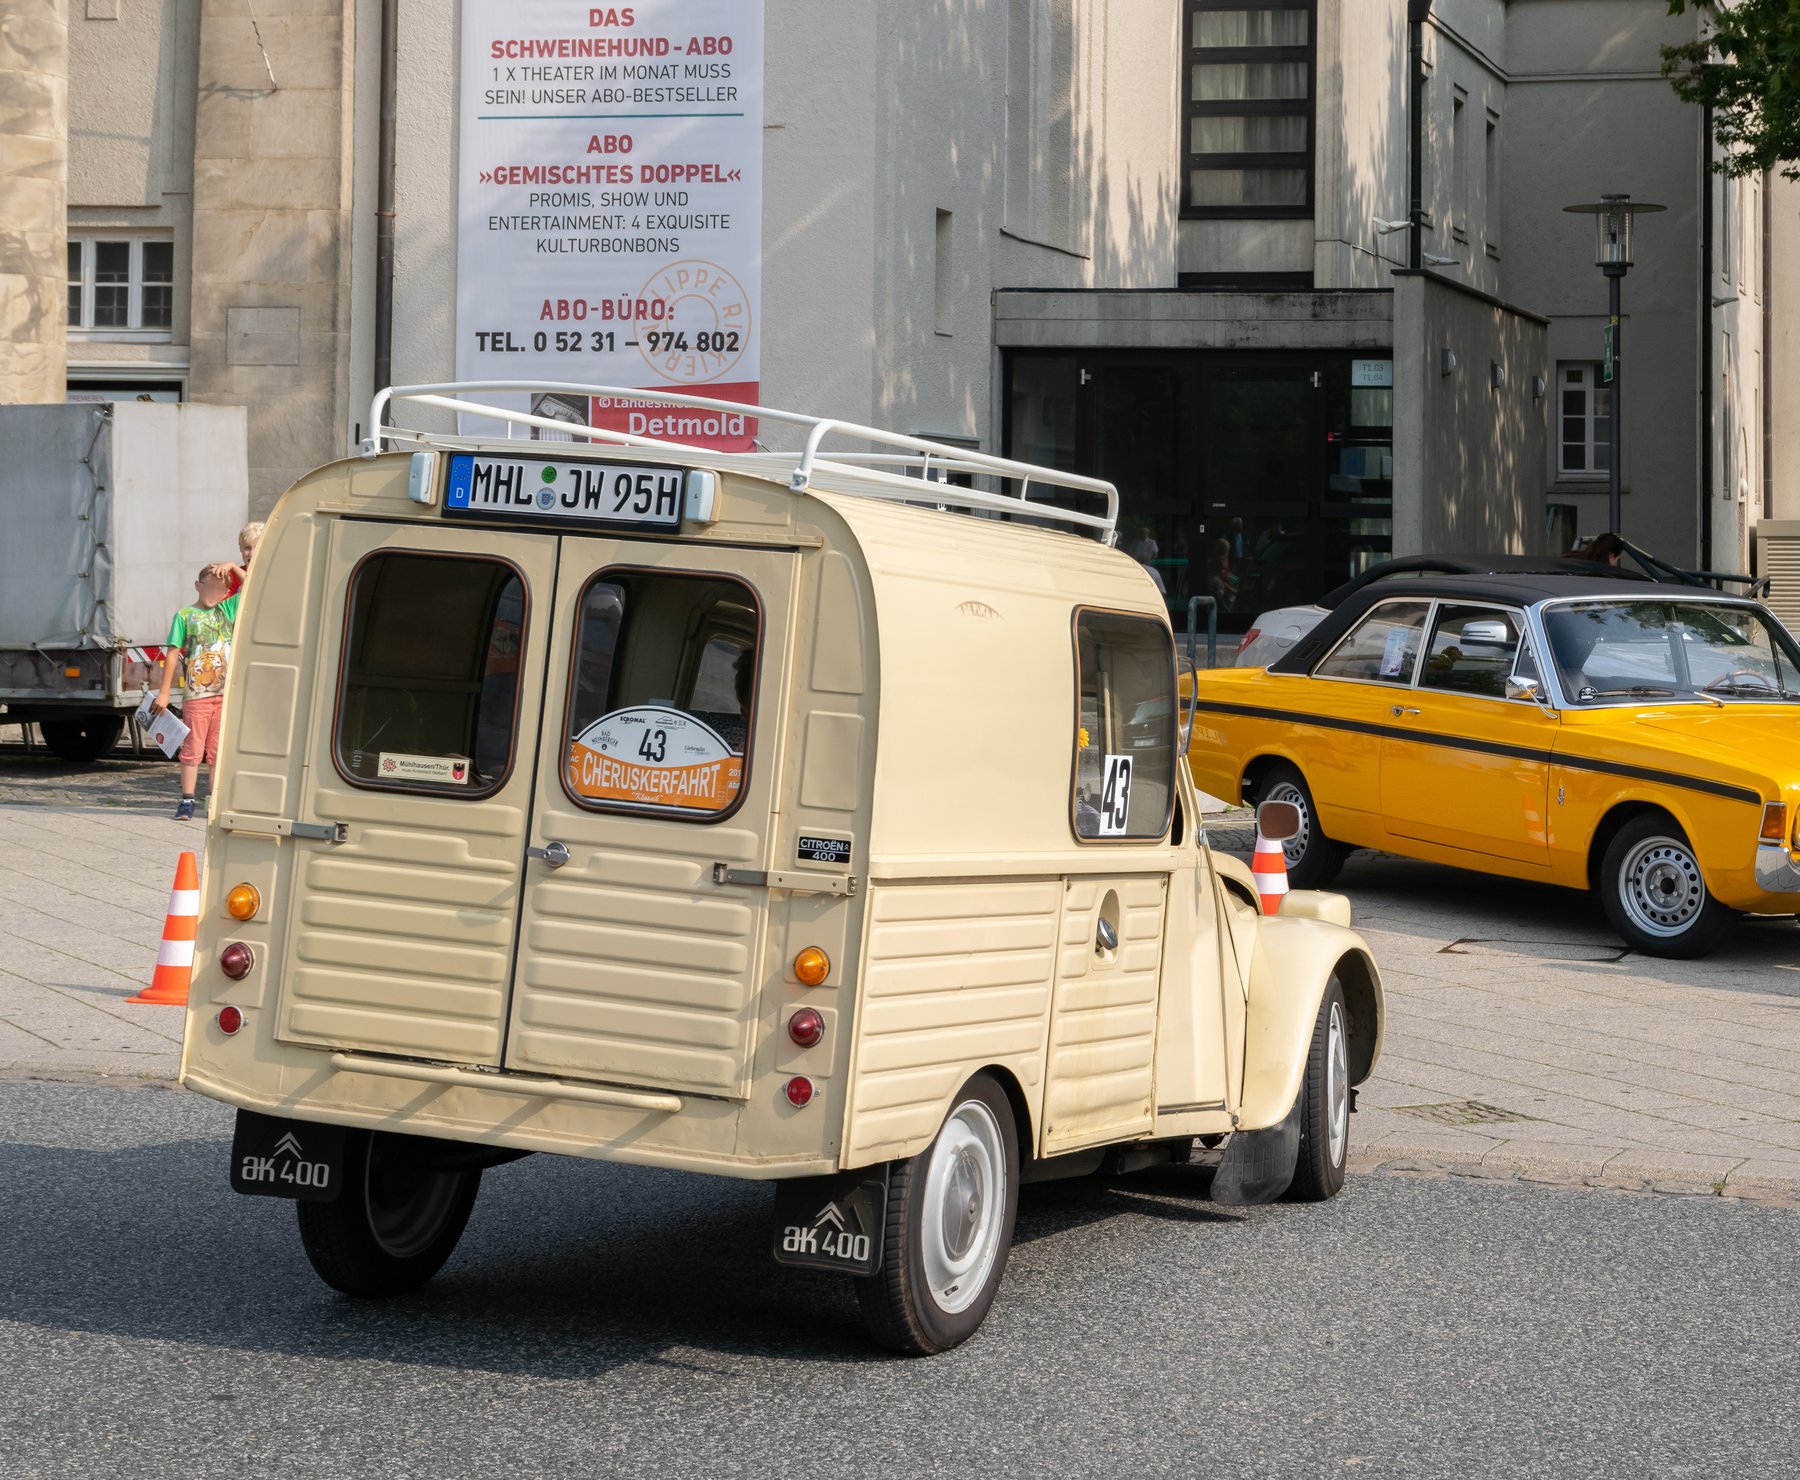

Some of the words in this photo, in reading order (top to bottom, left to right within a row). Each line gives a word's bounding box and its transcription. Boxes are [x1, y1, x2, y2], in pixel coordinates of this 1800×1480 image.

[589, 8, 635, 27] DAS
[490, 37, 669, 59] SCHWEINEHUND
[493, 67, 498, 82] 1
[505, 66, 516, 81] X
[521, 65, 594, 81] THEATER
[600, 65, 617, 80] IM
[623, 64, 679, 80] MONAT
[684, 63, 732, 79] MUSS
[484, 89, 526, 105] SEIN!
[531, 89, 586, 104] UNSER
[591, 87, 737, 103] ABO-BESTSELLER
[586, 134, 633, 154] ABO
[479, 165, 633, 185] »GEMISCHTES
[640, 164, 741, 184] DOPPEL«
[529, 192, 595, 209] PROMIS,
[600, 192, 650, 207] SHOW
[654, 191, 689, 207] UND
[488, 215, 626, 231] ENTERTAINMENT:
[631, 215, 640, 230] 4
[646, 214, 731, 230] EXQUISITE
[536, 238, 680, 253] KULTURBONBONS
[539, 293, 675, 321] ABO-BÜRO:
[475, 331, 526, 352] TEL.
[533, 331, 548, 352] 0
[555, 331, 583, 352] 52
[590, 331, 615, 352] 31
[646, 331, 689, 352] 974
[696, 331, 740, 352] 802
[628, 412, 745, 436] Detmold
[456, 488, 464, 498] D
[472, 463, 532, 505] MHL
[561, 469, 605, 510] JW
[613, 473, 678, 516] 95H
[638, 728, 667, 762] 43
[582, 751, 721, 798] CHERUSKERFAHRT
[1101, 758, 1131, 829] 43
[800, 838, 844, 851] CITROËN
[812, 851, 836, 861] 400
[280, 1160, 329, 1188] 400
[822, 1230, 870, 1261] 400
